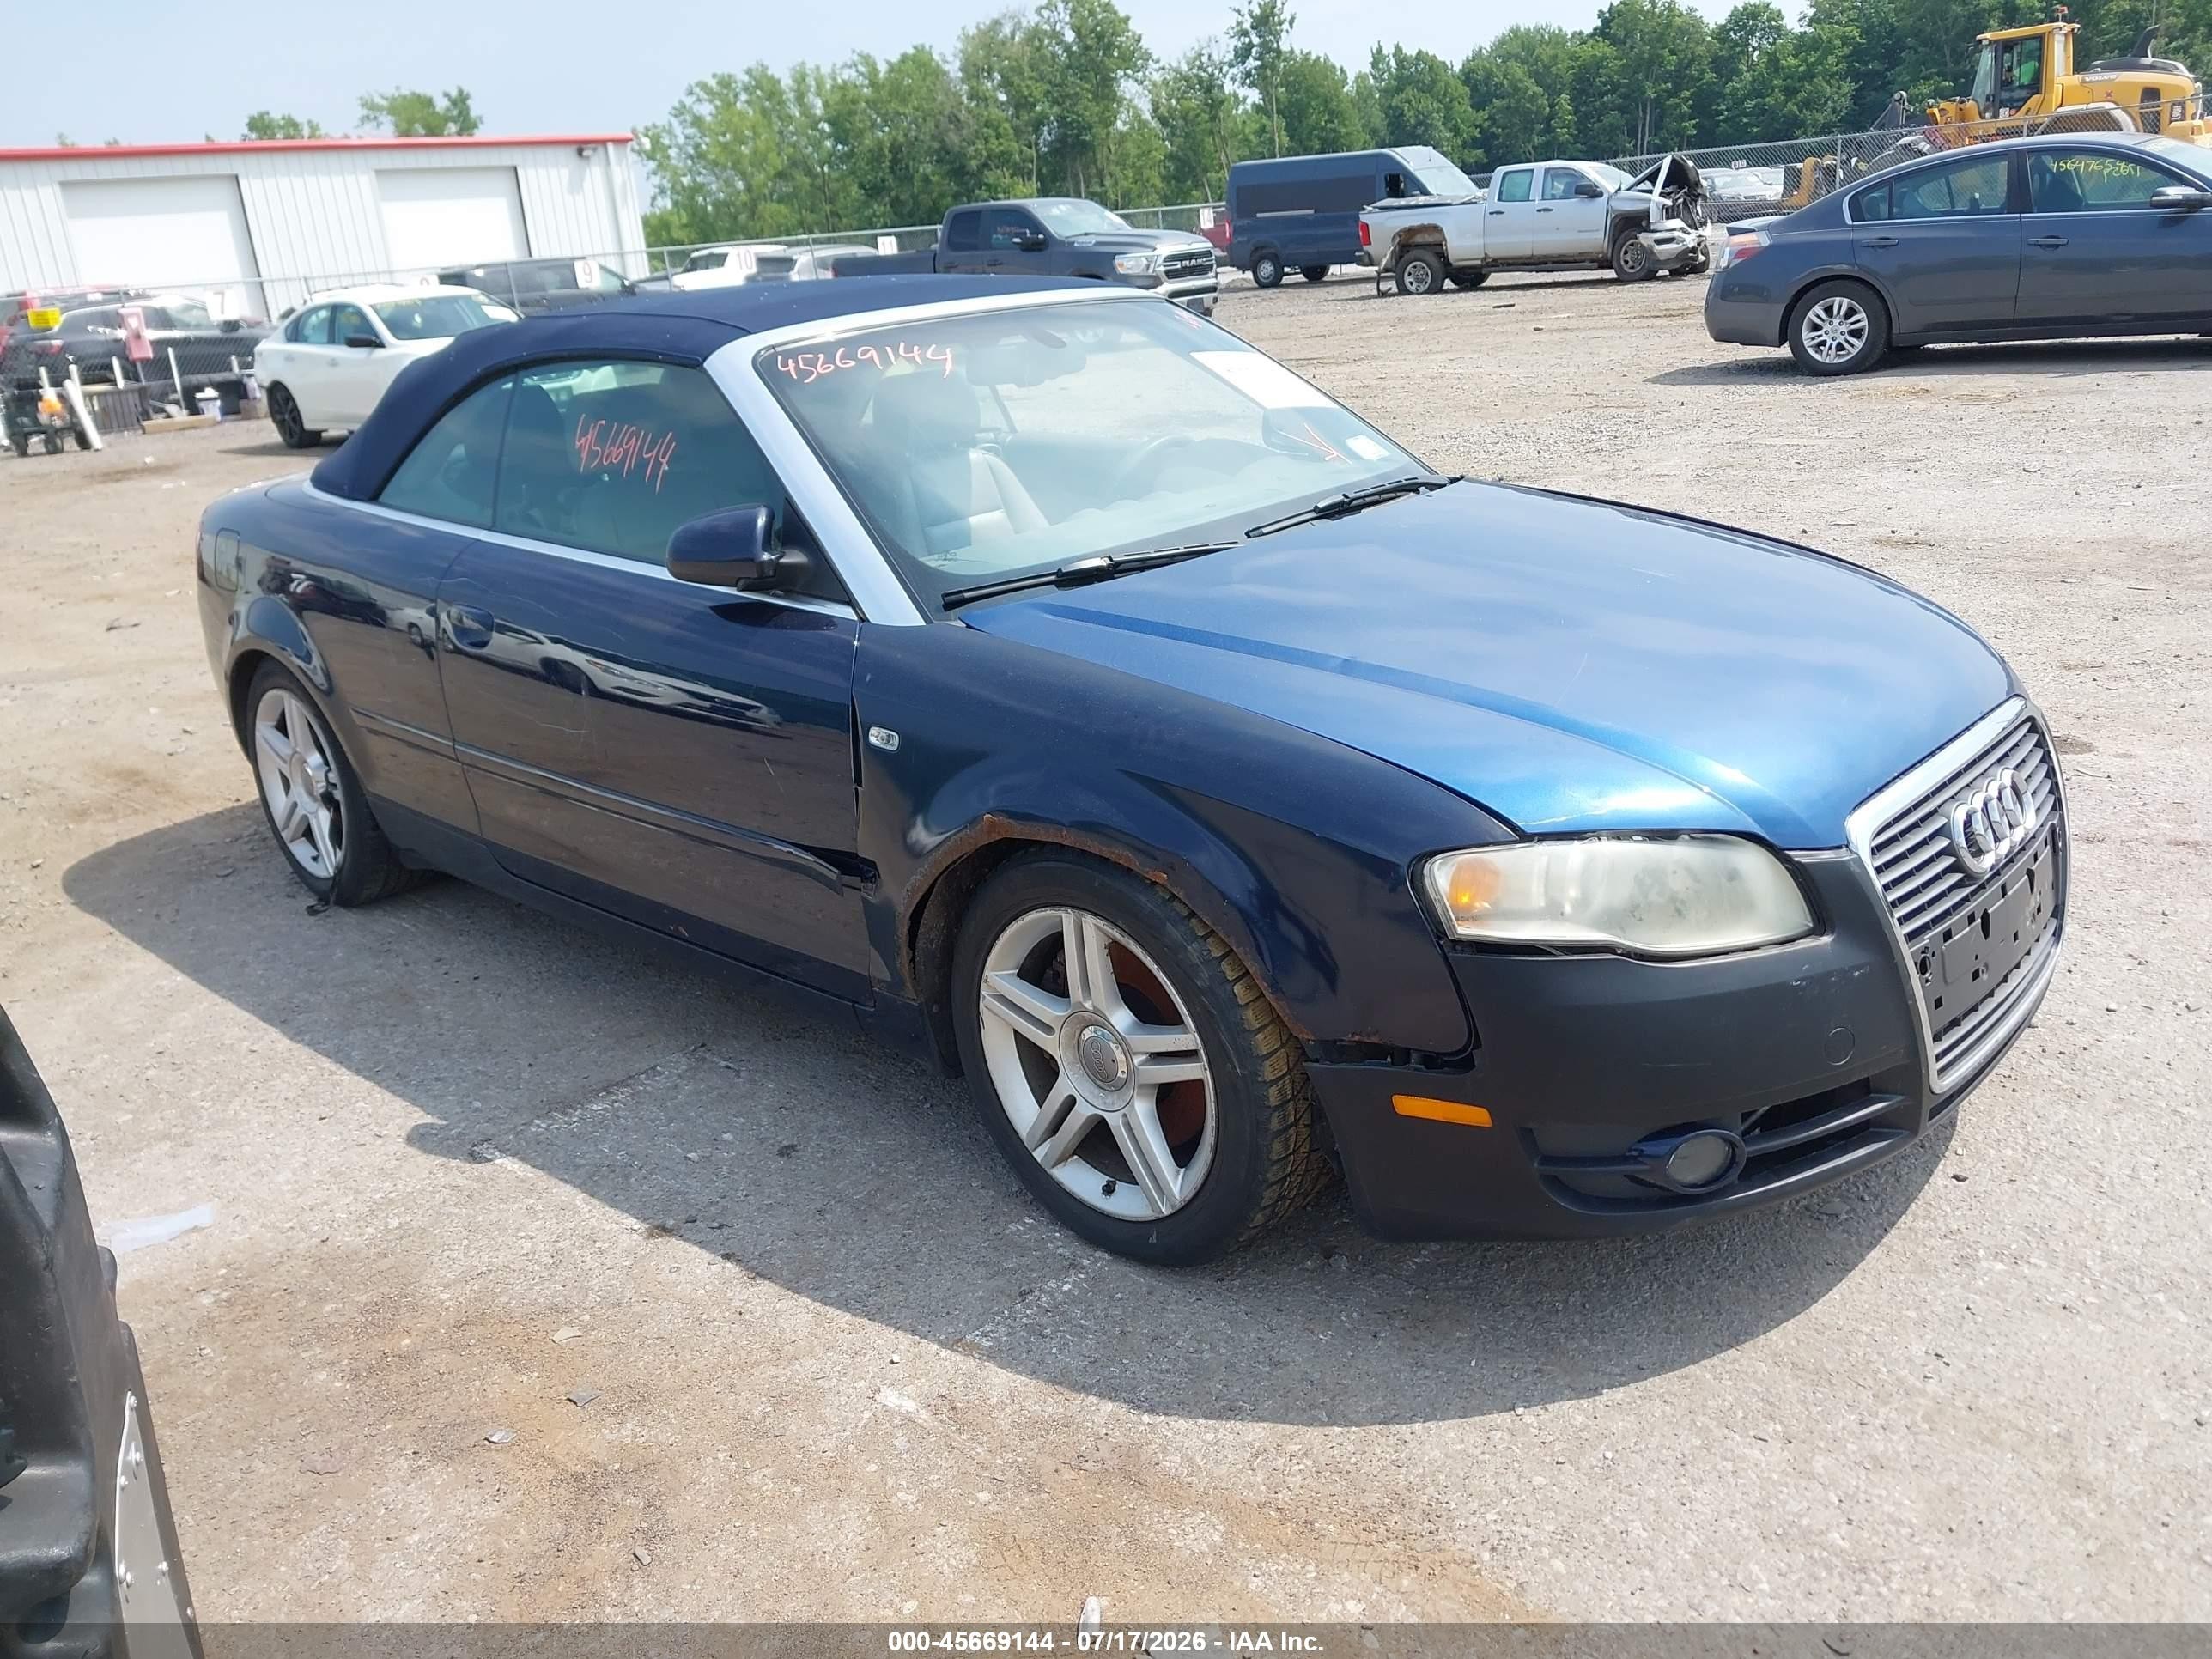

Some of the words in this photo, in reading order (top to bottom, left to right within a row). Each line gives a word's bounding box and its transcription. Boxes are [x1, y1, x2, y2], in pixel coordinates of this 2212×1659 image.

[2084, 73, 2118, 82] VOLVO
[584, 261, 592, 283] 9
[1181, 258, 1203, 267] RAM
[212, 291, 225, 315] 7
[777, 342, 953, 383] 45669144
[575, 413, 677, 495] 45669144
